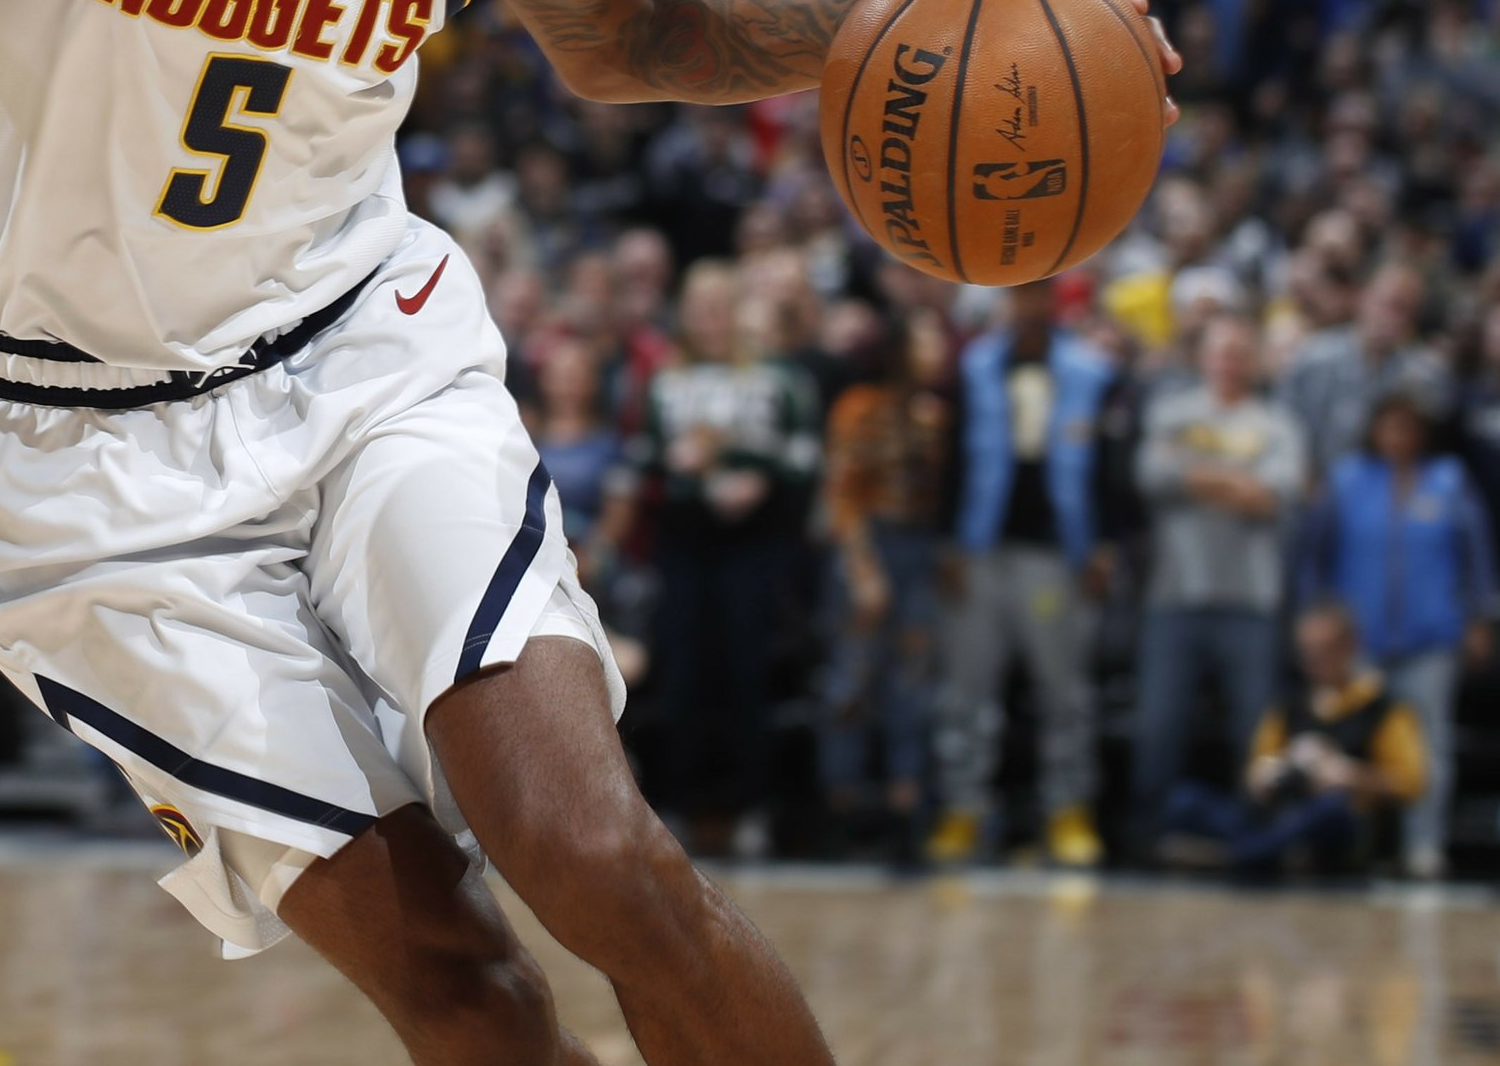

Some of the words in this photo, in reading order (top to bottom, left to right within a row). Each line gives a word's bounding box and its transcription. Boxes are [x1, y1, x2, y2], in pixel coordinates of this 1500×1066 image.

[152, 51, 294, 232] 5
[880, 43, 948, 269] SPALDING
[1045, 171, 1063, 192] NBA
[1004, 208, 1021, 226] BALL
